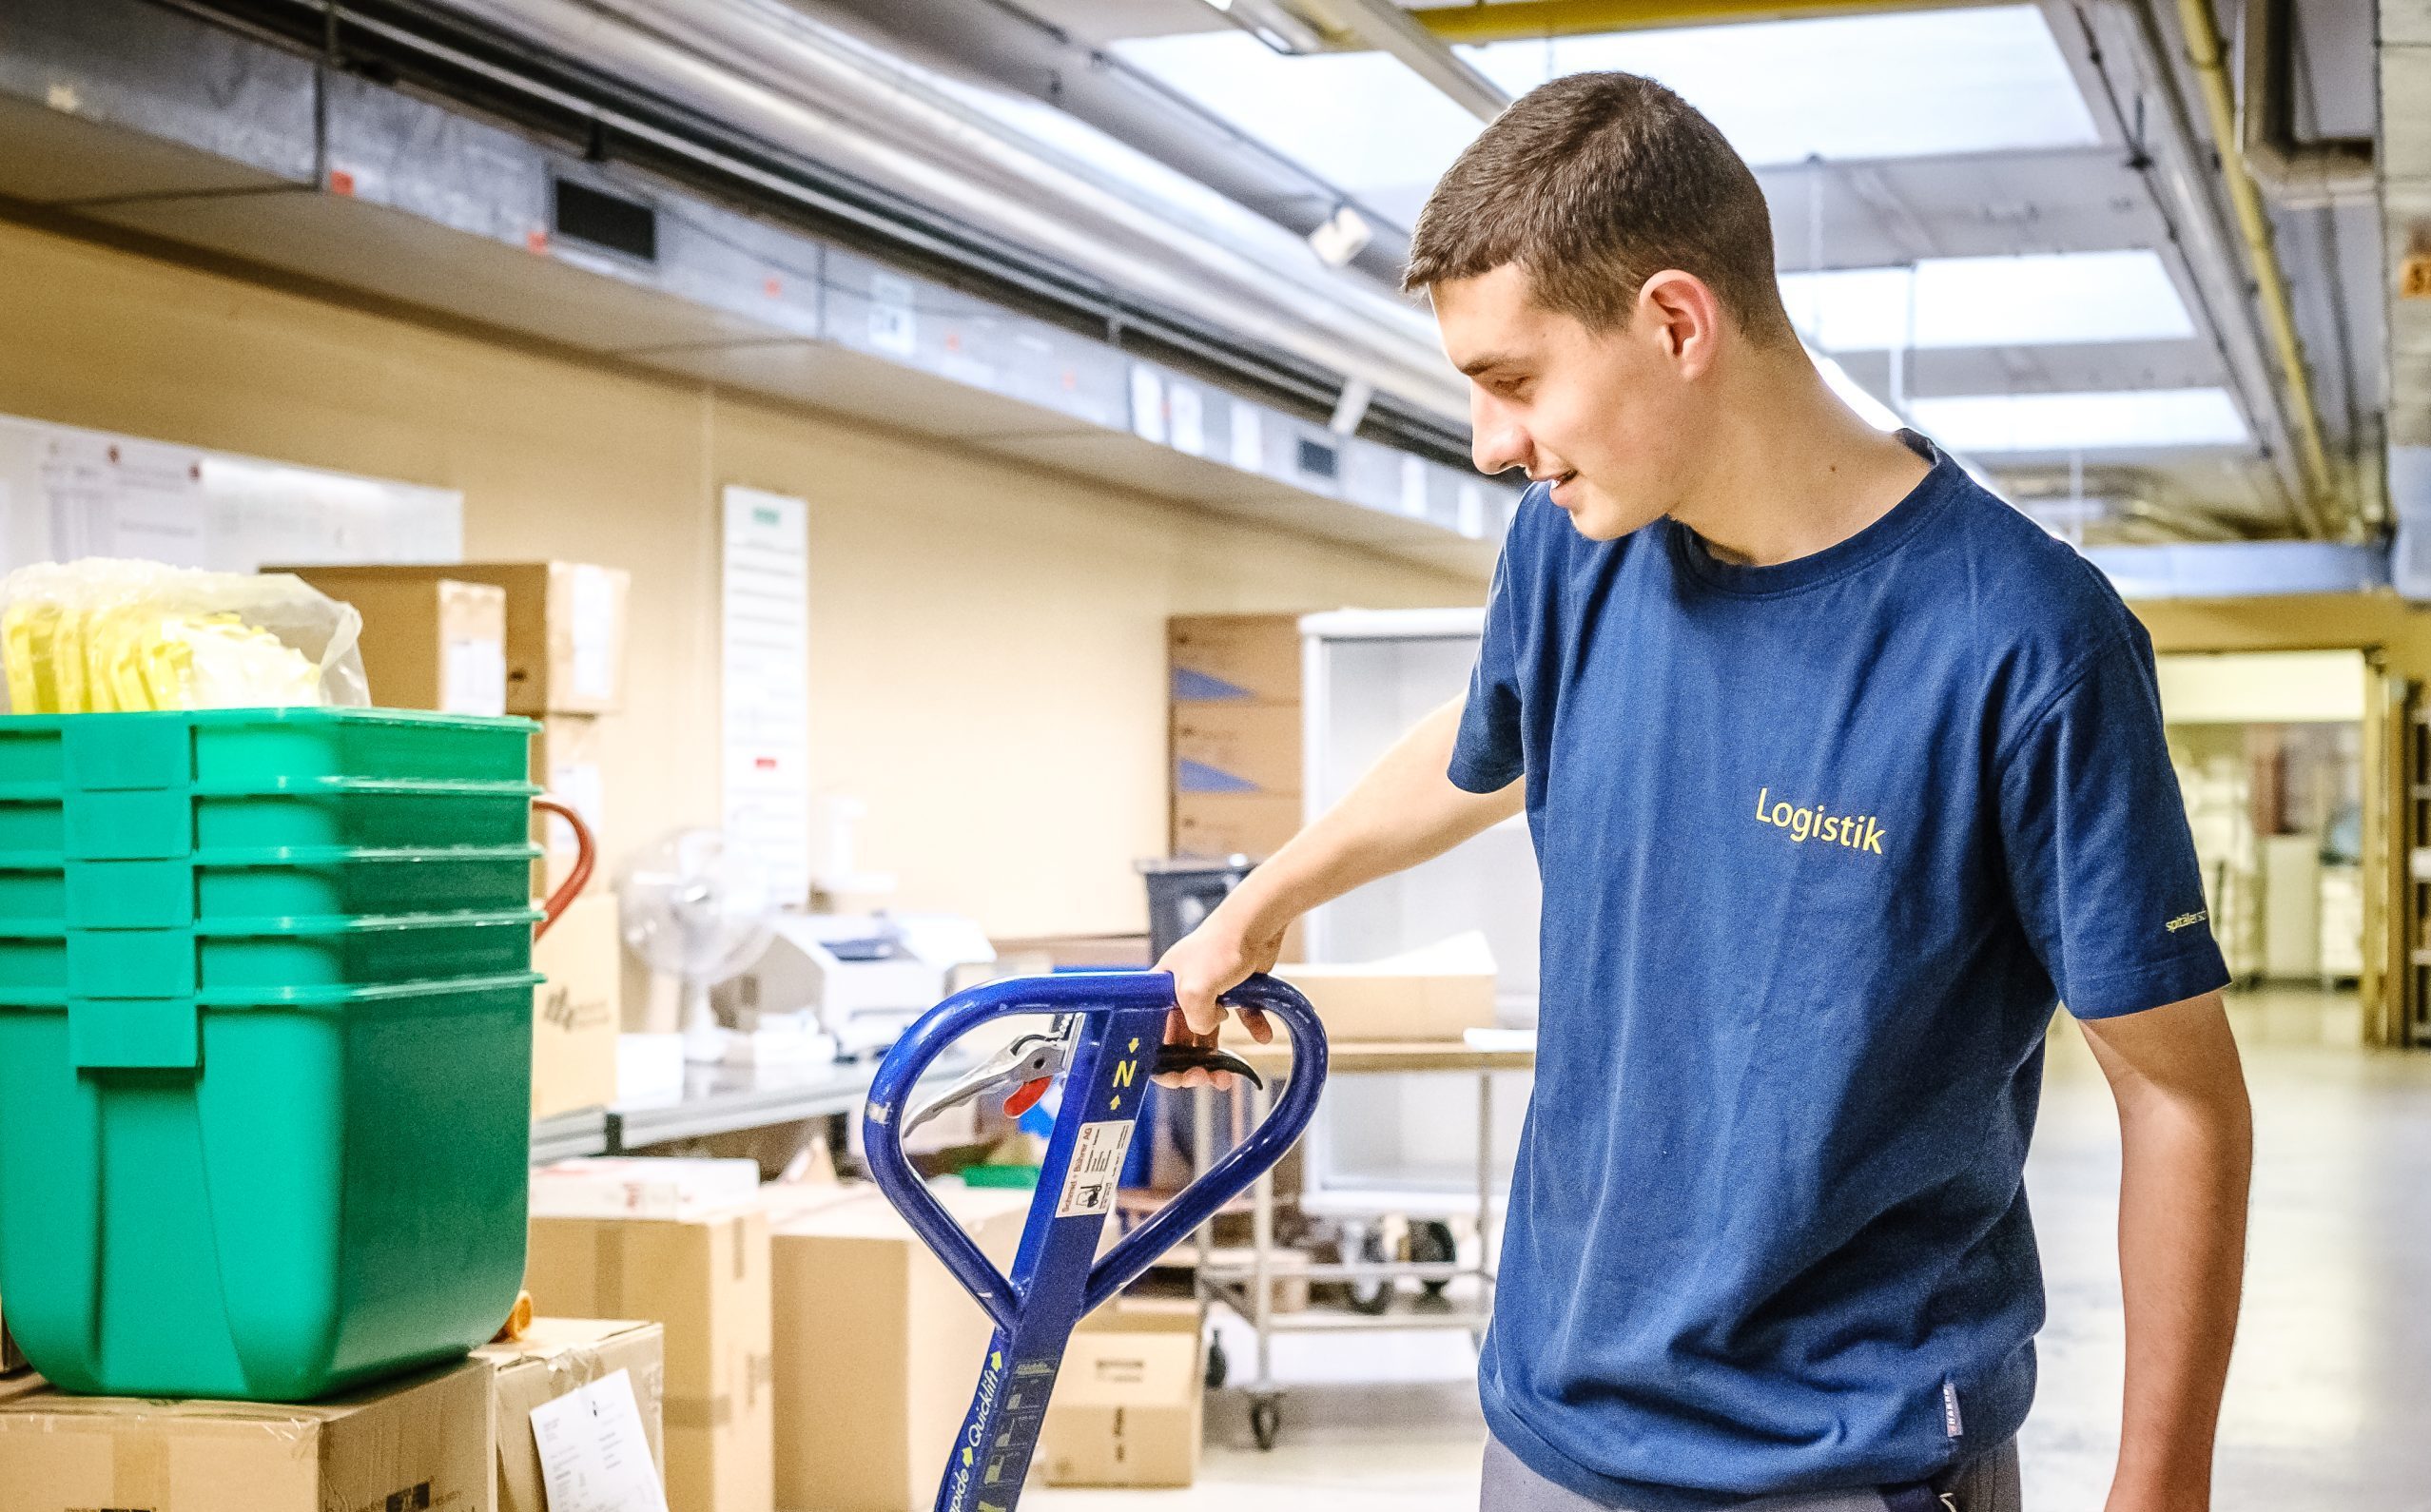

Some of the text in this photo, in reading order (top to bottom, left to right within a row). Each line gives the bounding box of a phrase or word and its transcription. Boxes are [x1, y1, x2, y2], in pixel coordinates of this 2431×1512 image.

[1756, 787, 1886, 855] Logistik
[1112, 1059, 1138, 1088] N
[1082, 1127, 1093, 1141] AG
[968, 1368, 999, 1447] Quicklift
